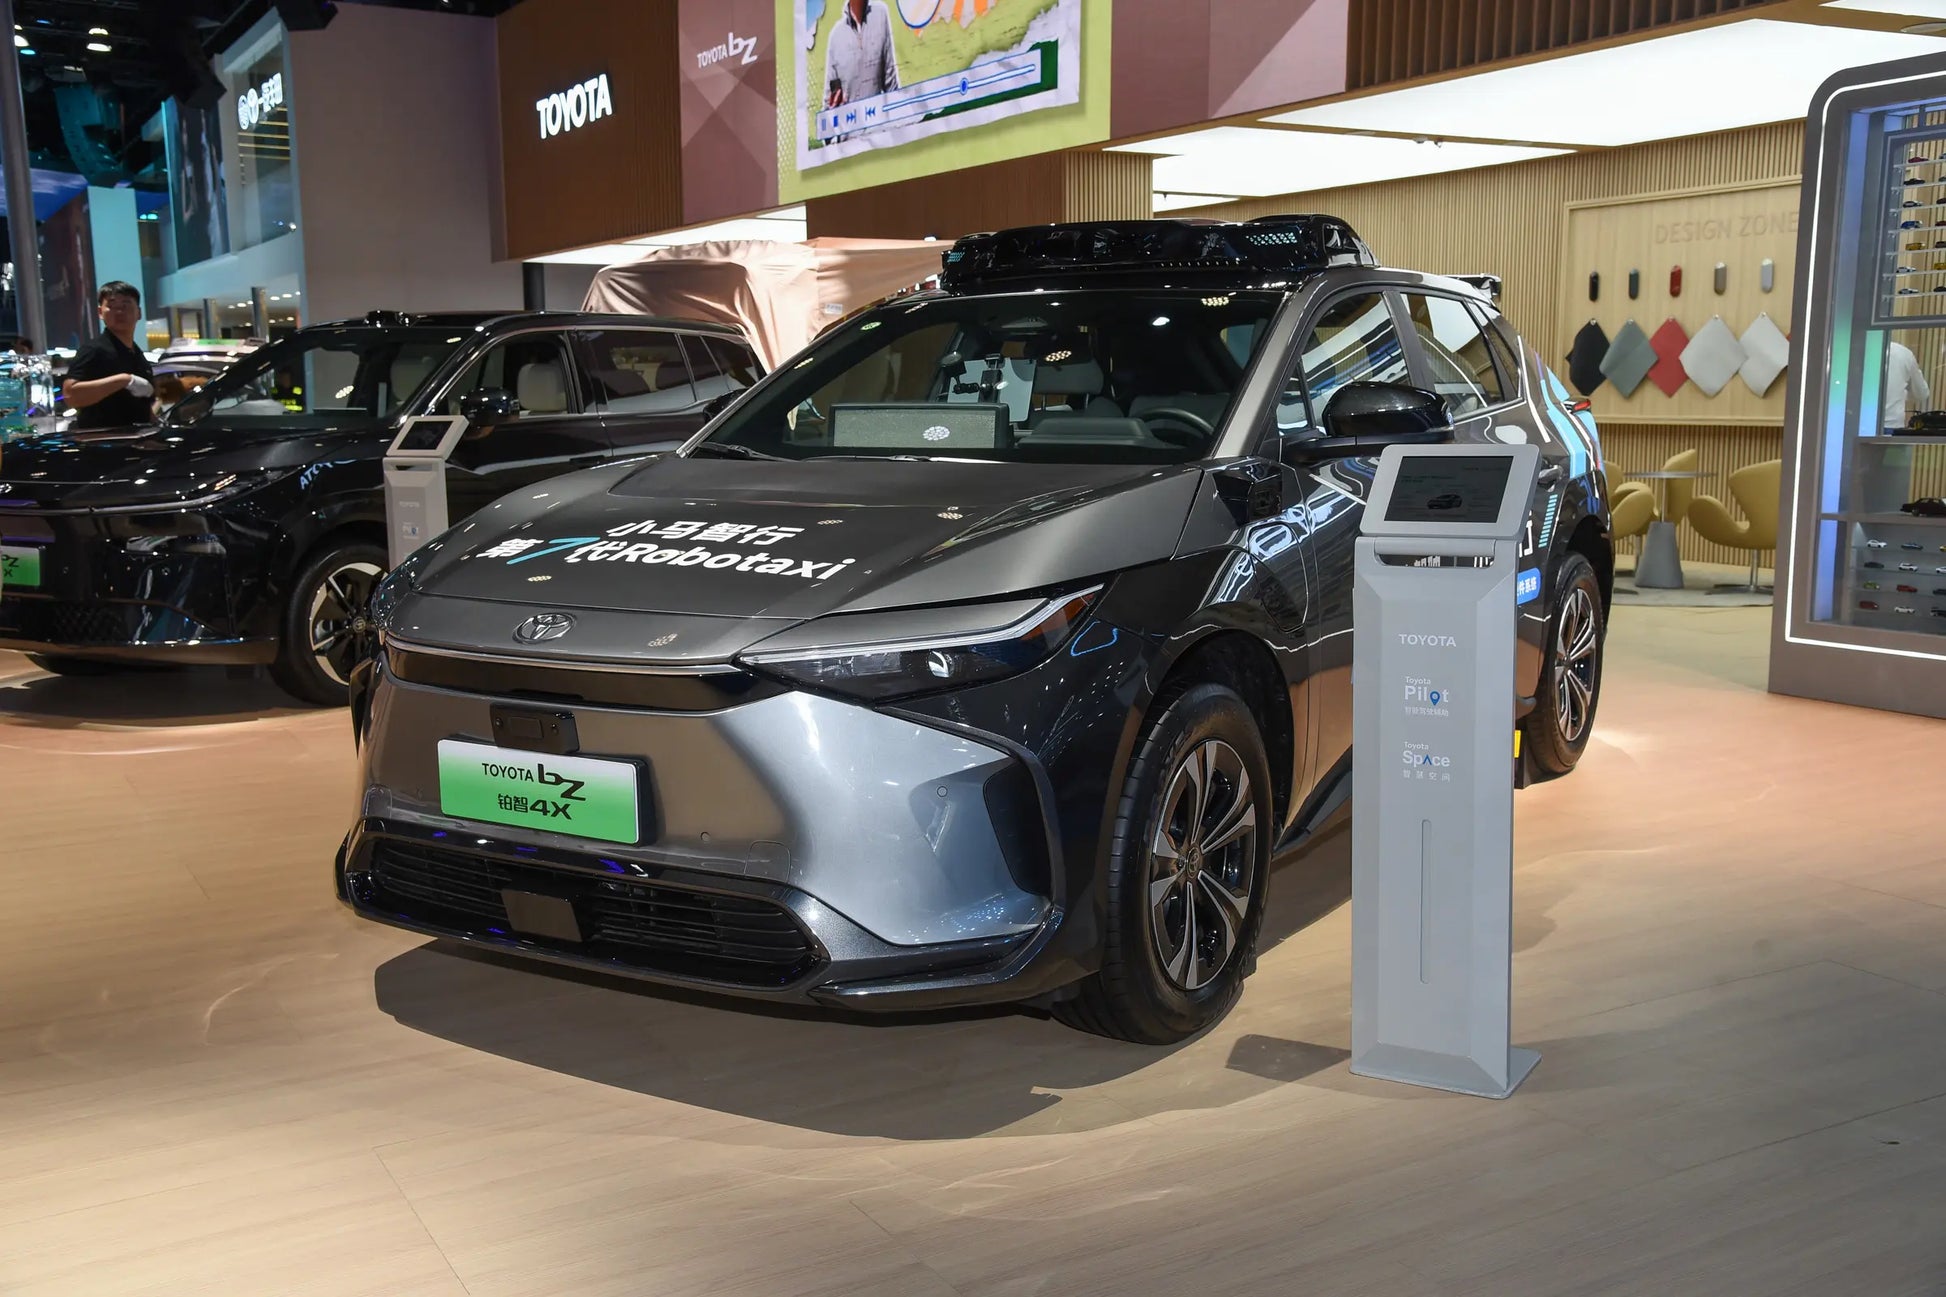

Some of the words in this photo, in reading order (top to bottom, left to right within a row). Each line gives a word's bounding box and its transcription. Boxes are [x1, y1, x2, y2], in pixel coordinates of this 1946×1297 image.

[697, 44, 728, 67] TOYOTA
[536, 73, 613, 139] TOYOTA
[1655, 219, 1732, 244] DESIGN
[1738, 211, 1799, 237] ZONE
[606, 520, 805, 545] 小马智行
[1399, 634, 1456, 647] TOYOTA
[1405, 676, 1431, 685] Toyota
[1405, 685, 1448, 706] Pilot
[1404, 741, 1429, 750] Toyota
[482, 763, 534, 782] TOYOTA
